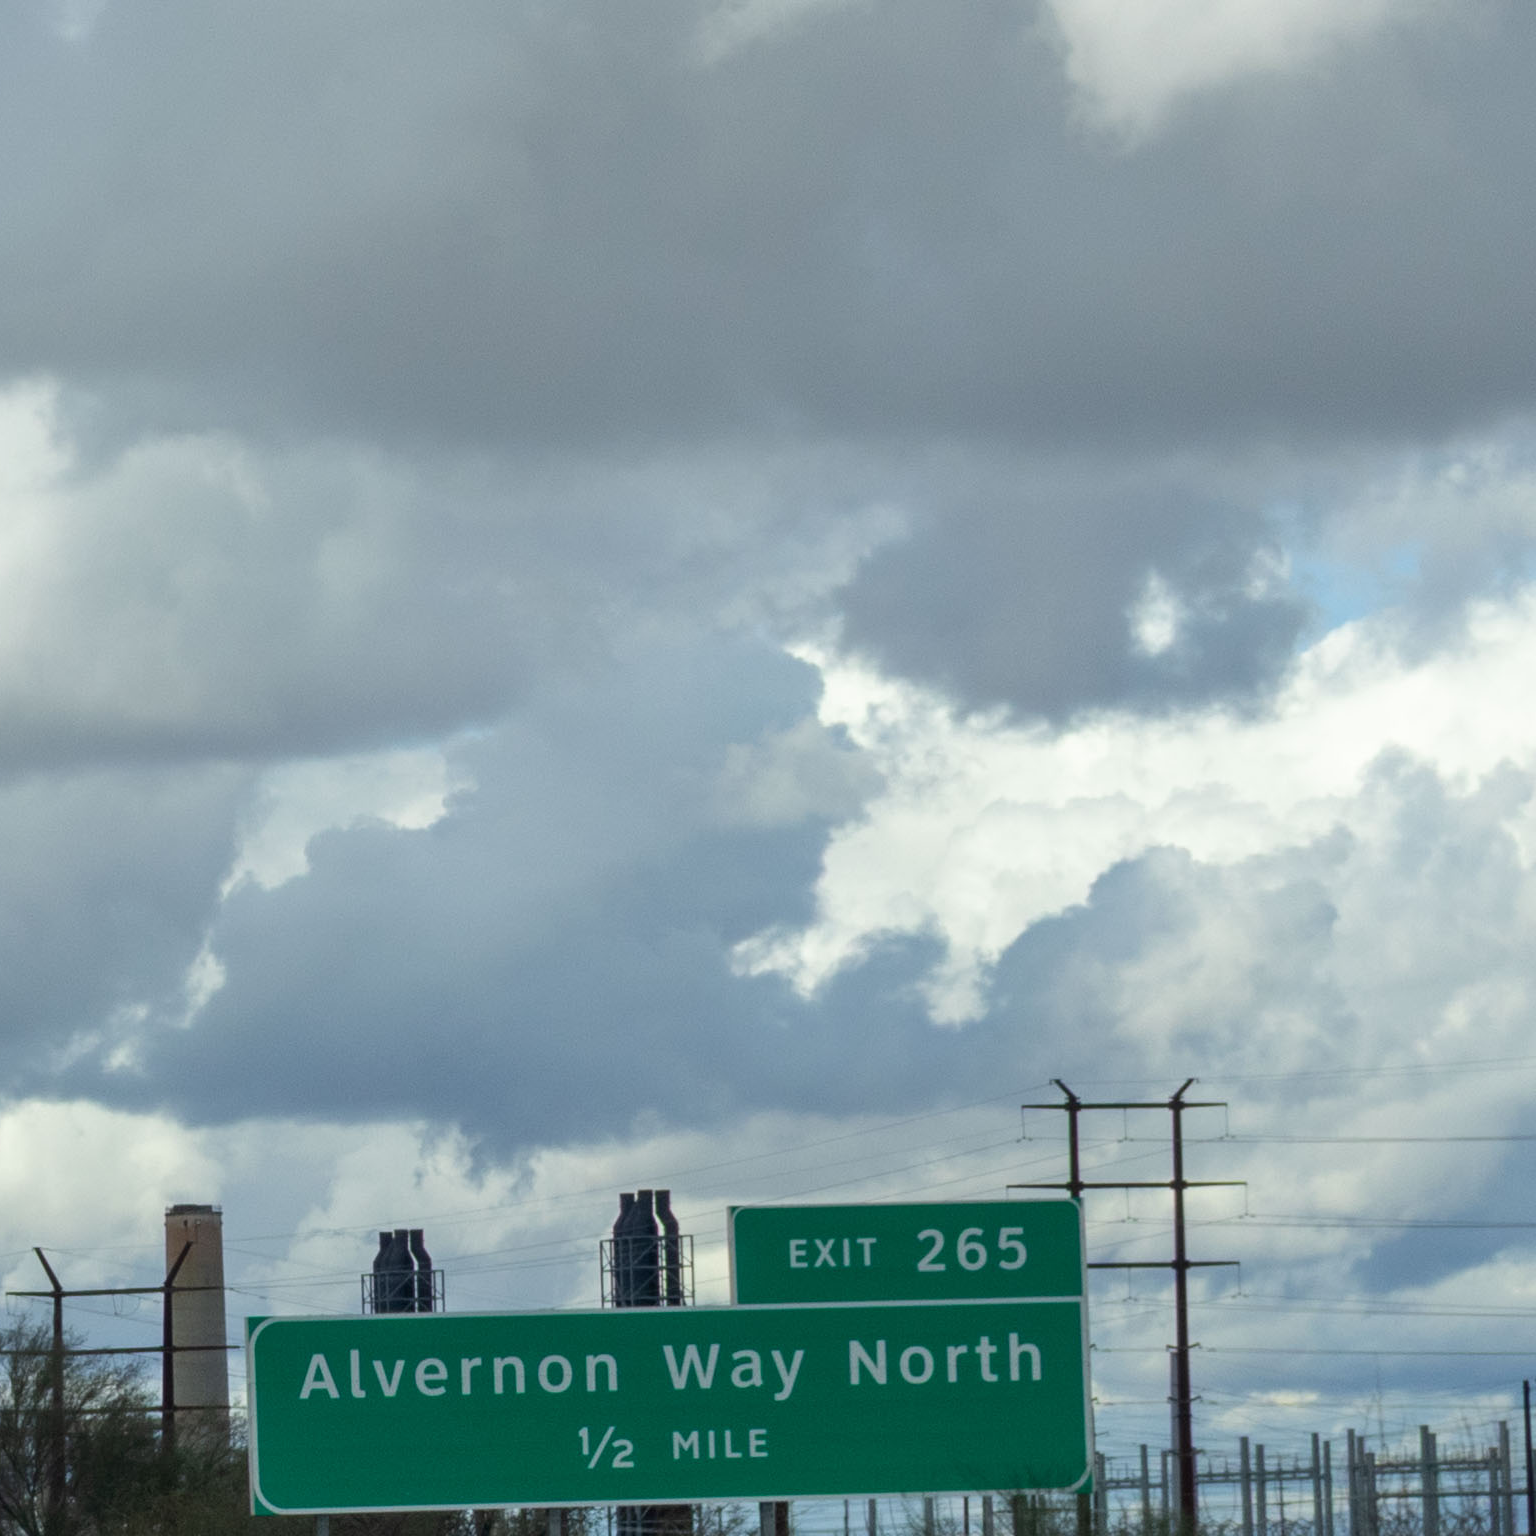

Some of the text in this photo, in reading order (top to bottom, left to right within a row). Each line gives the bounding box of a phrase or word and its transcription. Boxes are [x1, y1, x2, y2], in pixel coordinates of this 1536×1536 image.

[789, 1227, 1028, 1272] EXIT 265
[299, 1332, 1042, 1402] Alvernon Way North
[672, 1429, 768, 1460] MILE
